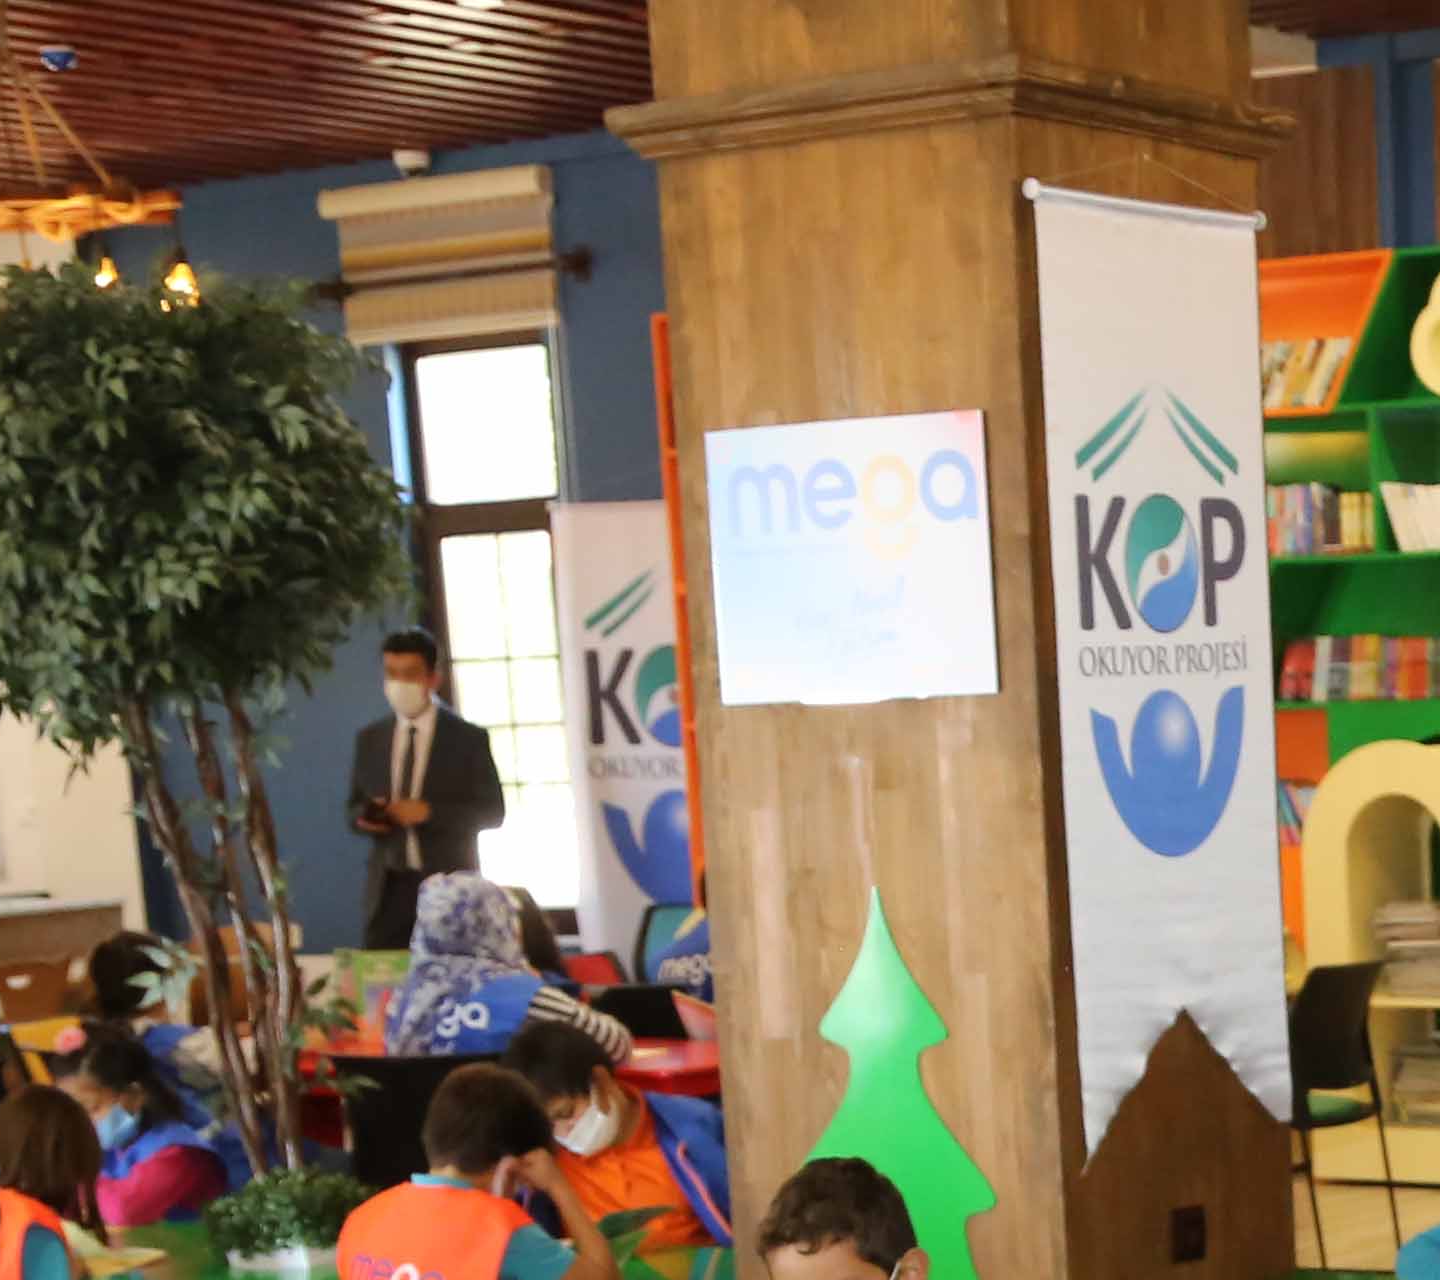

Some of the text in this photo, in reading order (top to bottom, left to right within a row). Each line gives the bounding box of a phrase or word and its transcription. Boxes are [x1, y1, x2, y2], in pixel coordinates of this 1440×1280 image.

[727, 448, 980, 562] mega
[1074, 492, 1246, 635] KOP
[583, 645, 681, 749] KO
[1079, 634, 1248, 678] OKUYOR PROJESİ
